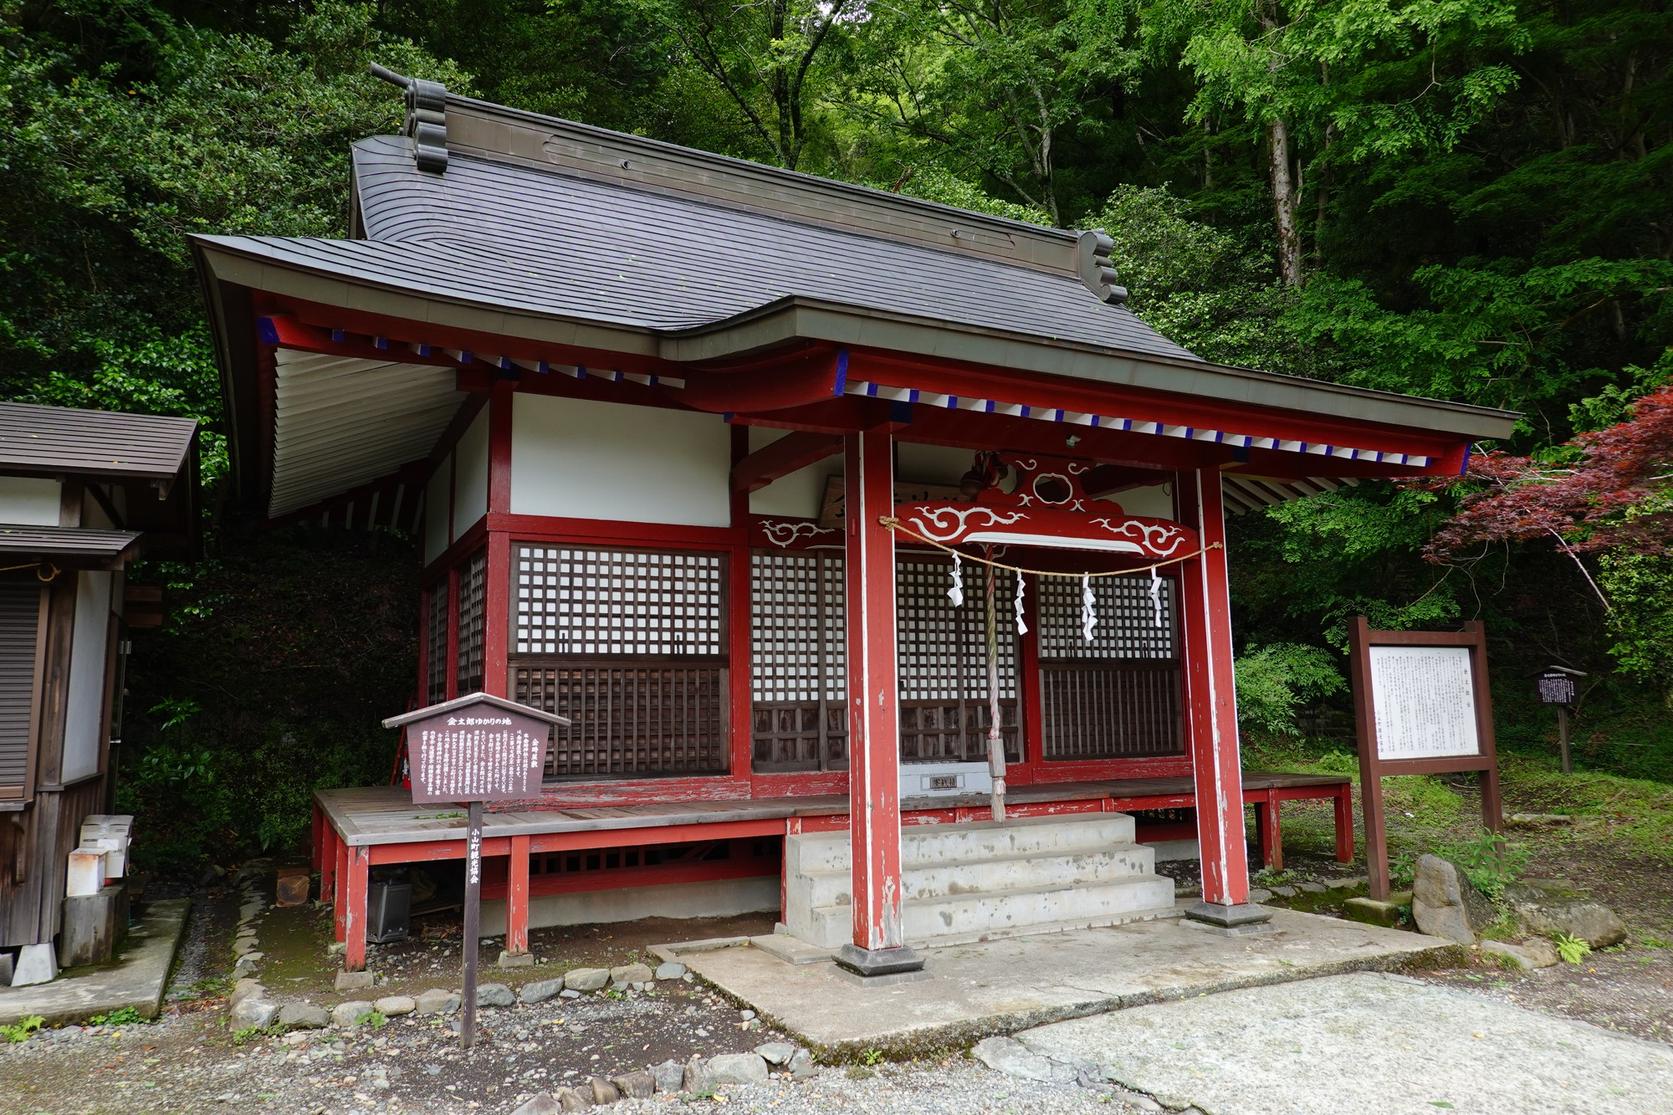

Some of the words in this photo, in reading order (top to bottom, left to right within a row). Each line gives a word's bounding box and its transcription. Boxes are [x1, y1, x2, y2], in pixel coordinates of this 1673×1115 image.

[447, 717, 512, 726] 金太郎ゆかりの地
[469, 828, 480, 884] 小山町観光協会
